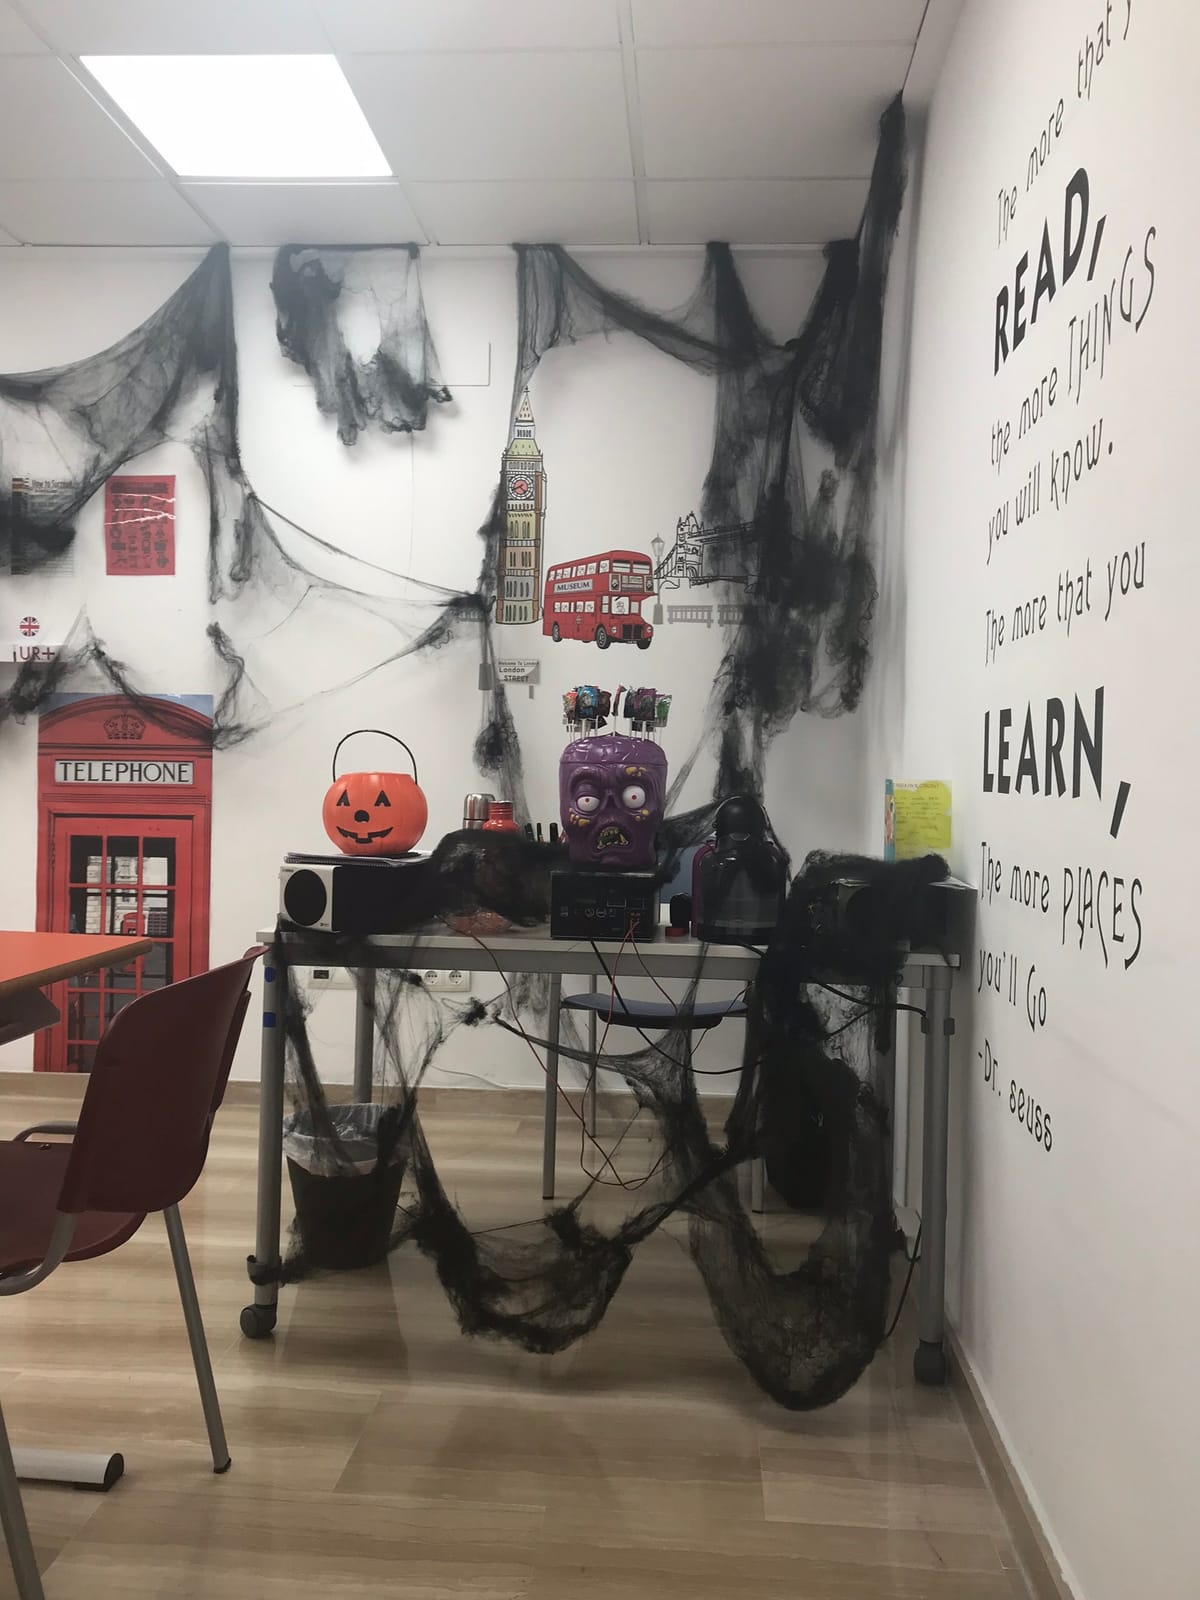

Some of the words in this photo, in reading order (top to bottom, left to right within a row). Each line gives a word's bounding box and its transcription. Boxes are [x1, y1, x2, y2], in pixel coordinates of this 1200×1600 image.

[998, 185, 1017, 249] The
[1026, 98, 1064, 192] more
[1077, 0, 1112, 101] that
[994, 167, 1107, 377] READ,
[991, 419, 1011, 476] the
[1018, 367, 1058, 440] more
[1068, 226, 1156, 405] THINGS
[986, 500, 1009, 566] you
[1015, 461, 1041, 527] will
[1050, 418, 1113, 511] know.
[556, 581, 590, 591] MUSEUM
[985, 609, 1005, 667] The
[1011, 595, 1047, 642] more
[1056, 557, 1093, 638] that
[1104, 541, 1146, 622] you
[58, 761, 191, 784] TELEPHONE
[983, 685, 1132, 840] LEARN,
[980, 841, 1002, 905] The
[1010, 864, 1050, 913] more
[1061, 866, 1143, 970] PLACES
[977, 948, 1018, 1006] you'll
[1026, 964, 1047, 1032] Go
